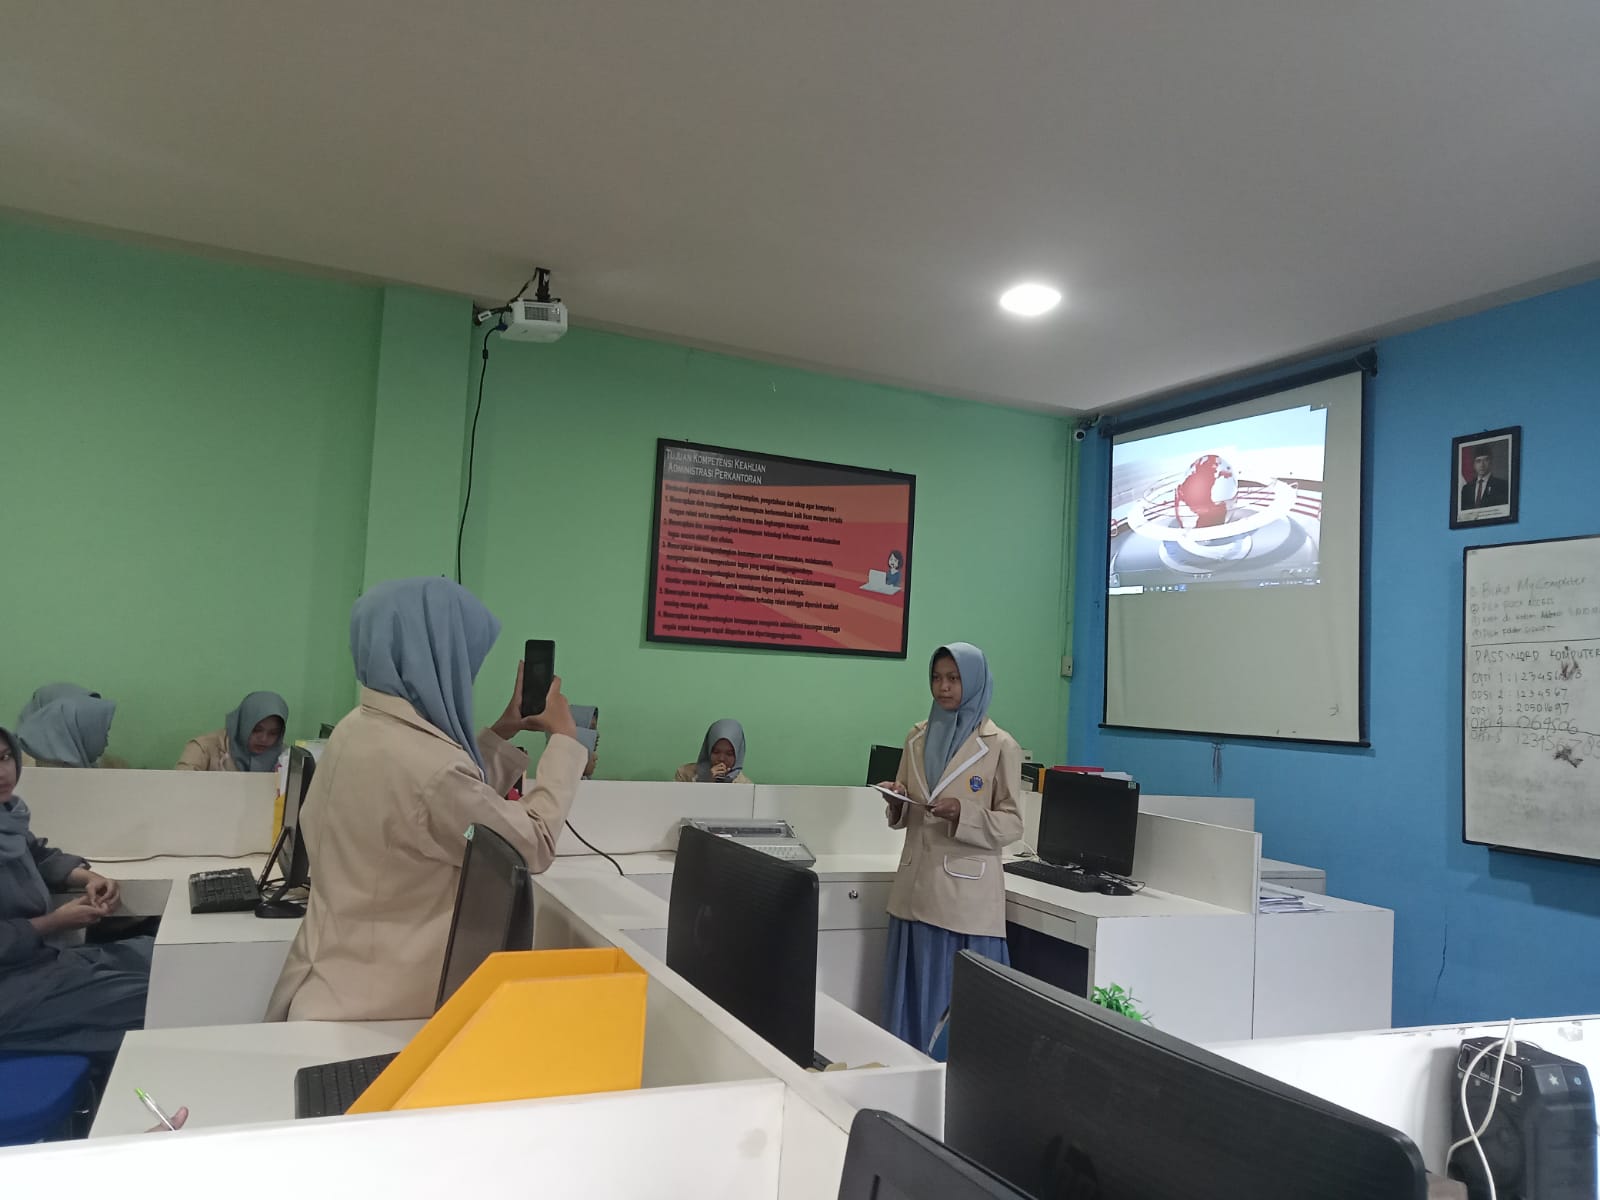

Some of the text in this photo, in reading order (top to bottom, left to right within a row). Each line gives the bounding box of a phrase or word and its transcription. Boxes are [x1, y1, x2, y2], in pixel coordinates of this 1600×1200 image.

[668, 462, 762, 484] ADMINISTRASI PERKANTORAN
[693, 454, 734, 468] KOMPETENSI
[734, 459, 767, 473] KEAHLIAN
